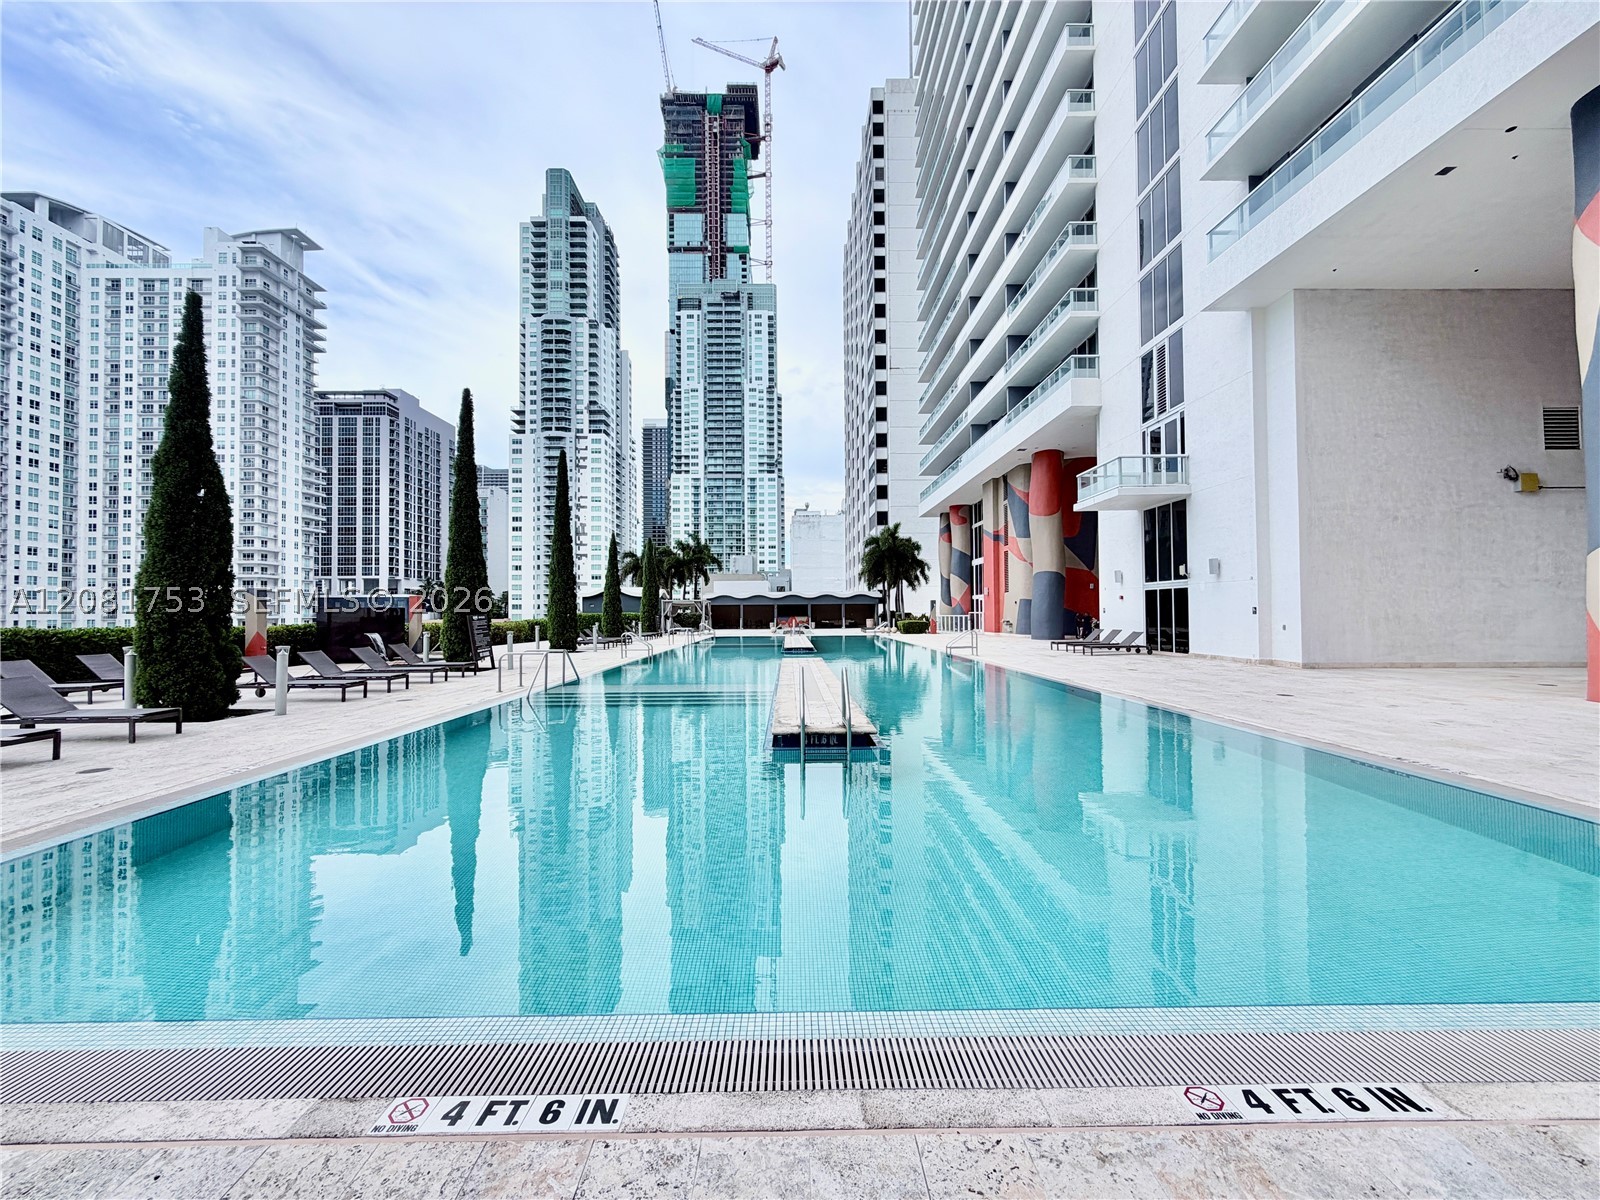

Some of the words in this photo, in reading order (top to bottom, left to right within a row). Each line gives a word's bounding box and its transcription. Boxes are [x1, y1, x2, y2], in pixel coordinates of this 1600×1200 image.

[1241, 1089, 1274, 1114] 4
[1271, 1088, 1336, 1114] FT.
[1331, 1087, 1370, 1112] 6
[1363, 1087, 1433, 1112] IN.
[440, 1100, 471, 1126] 4
[475, 1100, 530, 1126] FT.
[538, 1099, 565, 1124] 6
[574, 1098, 619, 1124] IN.
[1196, 1112, 1211, 1120] NO
[1211, 1112, 1243, 1120] DIVING
[371, 1125, 386, 1133] NO
[386, 1124, 418, 1133] DIVING
